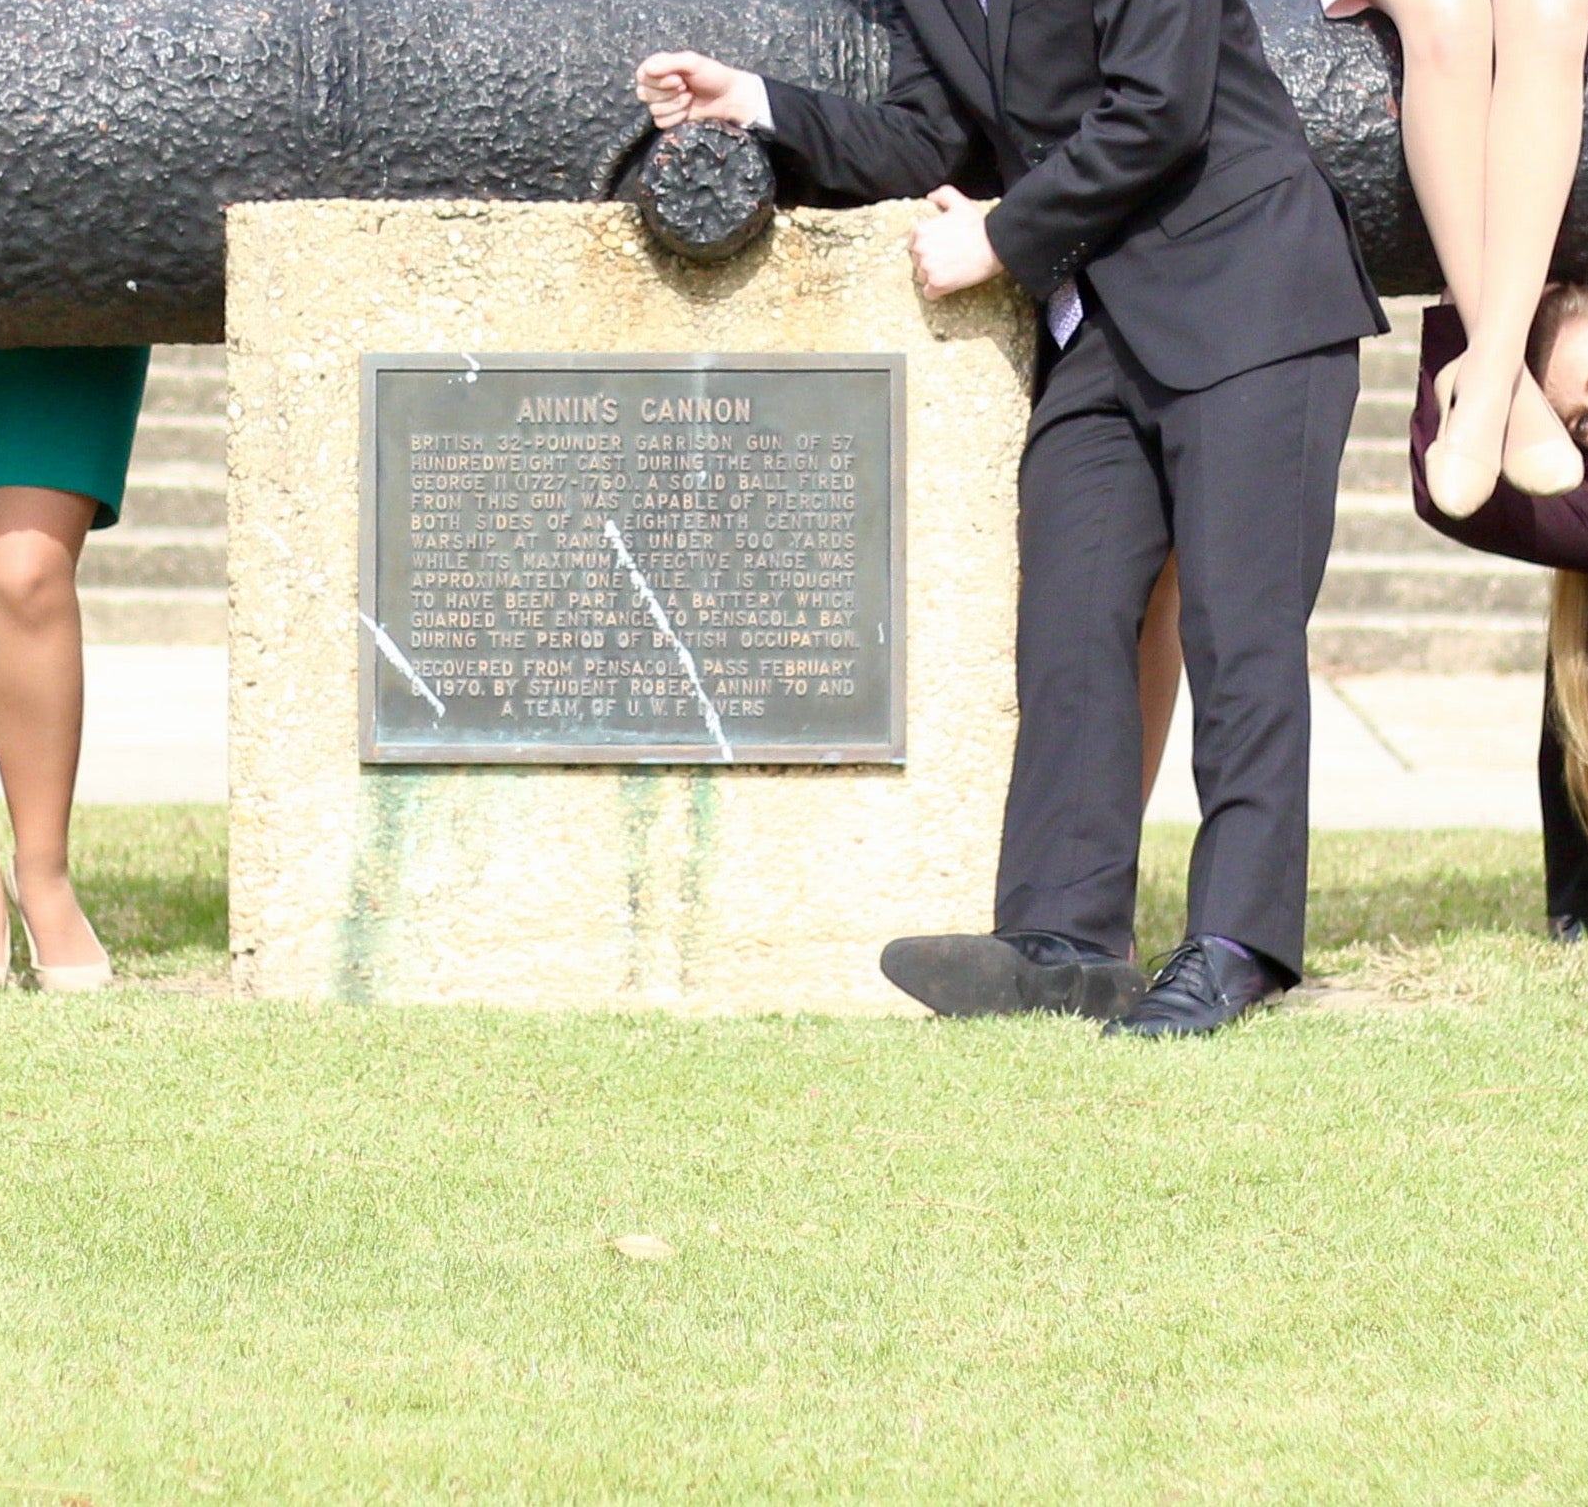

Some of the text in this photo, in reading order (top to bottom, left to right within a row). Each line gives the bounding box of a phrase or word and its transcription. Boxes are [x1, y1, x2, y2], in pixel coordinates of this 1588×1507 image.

[516, 394, 751, 423] ANNIN'S CANNON
[411, 435, 854, 452] BRITISH 32-POUNDER GARRISON GUN OF 57
[411, 454, 855, 471] HUNDREDWEIGHT CAST DURING THE REIGN OF
[412, 475, 485, 491] GEORGE
[494, 475, 507, 491] II
[647, 475, 659, 491] A
[669, 475, 725, 491] SOLID
[739, 475, 787, 491] BALL
[798, 475, 855, 491] FIRED
[411, 494, 855, 510] FROM THIS GUN WAS CAPABLE OF PIERCING
[411, 514, 855, 530] BOTH SIDES OF AN EIGHTEENTH CENTURY
[411, 533, 855, 550] WARSHIP AT RANGS UNDER 500 YARDS
[412, 553, 855, 569] WHILE ITS MAXIMUM FFECTIVE RANGE WAS
[412, 573, 572, 589] APPROXIMATELY
[585, 573, 623, 589] ONE
[704, 573, 722, 589] IT
[736, 573, 754, 589] IS
[768, 573, 855, 589] THOUGHT
[411, 593, 855, 609] TO HAVE BEEN PART O A BATTERY WHICH
[412, 611, 855, 628] GUARDED THE ENTRANCE TO PENSACOLA BAY
[411, 631, 477, 648] DURING
[489, 631, 526, 648] THE
[537, 631, 605, 648] PERIOD
[618, 631, 642, 648] OF
[740, 631, 860, 648] OCCUPATION.
[412, 659, 513, 676] RECOVERED
[523, 659, 572, 676] FROM
[703, 659, 749, 676] PASS
[761, 659, 855, 676] FEBRUARY
[494, 680, 519, 696] BY
[529, 680, 619, 696] STUDENT
[630, 680, 704, 696] ROBER
[715, 680, 772, 696] ANNIN
[818, 680, 854, 696] AND
[500, 699, 513, 716] A
[591, 699, 616, 716] OF
[698, 699, 765, 716] DVERS
